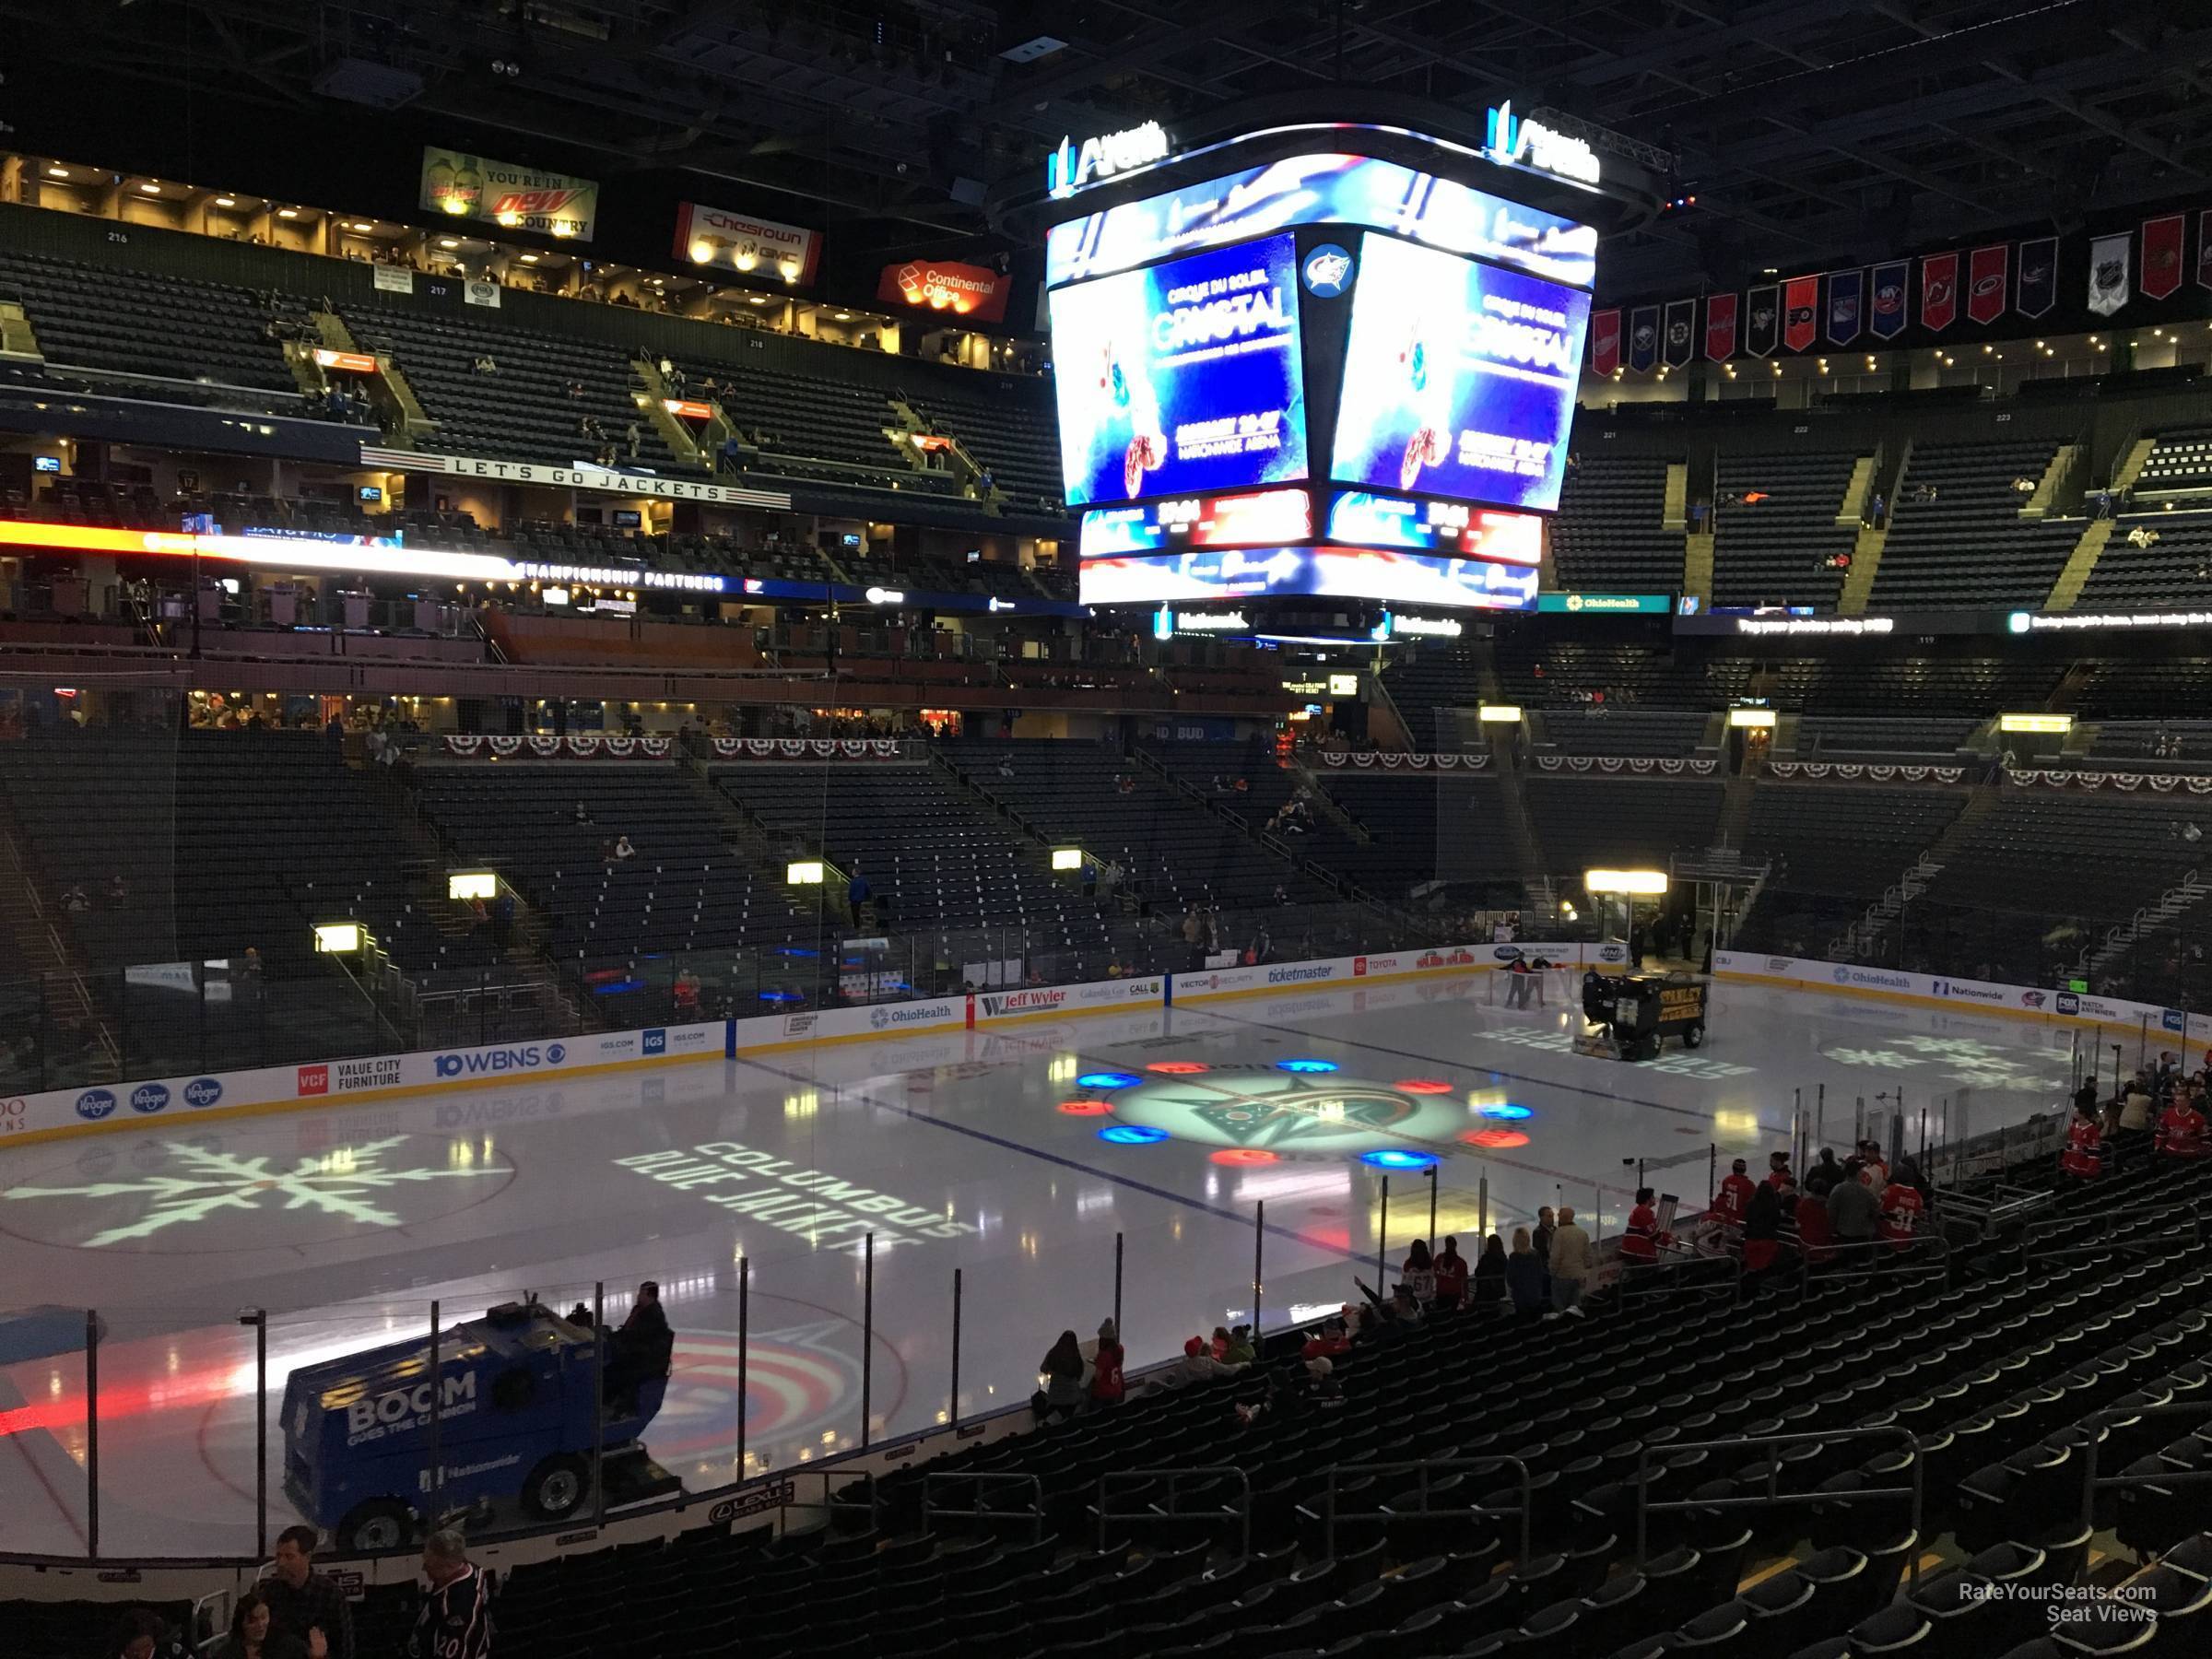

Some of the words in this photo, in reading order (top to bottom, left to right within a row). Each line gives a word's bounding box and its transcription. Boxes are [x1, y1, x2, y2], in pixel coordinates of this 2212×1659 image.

[487, 171, 541, 187] YOU'RE
[542, 177, 562, 189] IN
[515, 214, 587, 232] COUNTRY
[703, 213, 801, 245] Chesrown
[108, 232, 127, 243] 216
[759, 247, 798, 263] GMC
[430, 285, 447, 296] 217
[926, 270, 994, 295] Continental
[1210, 277, 1227, 295] DU
[1229, 268, 1269, 291] SOLEIL
[923, 284, 960, 302] Office
[750, 340, 763, 349] 218
[454, 459, 532, 479] LET'S
[552, 470, 583, 485] GO
[600, 476, 719, 500] JACKETS
[514, 562, 640, 586] CHAMPIONSHIP
[645, 571, 724, 592] PARTNERS
[1584, 598, 1640, 608] OhioHealth
[1919, 636, 1935, 644] 119
[1177, 726, 1205, 739] BUD
[1369, 959, 1397, 970] TOYOTA
[1715, 957, 1732, 965] CBJ
[1268, 965, 1333, 983] ticketmaster
[1852, 972, 1911, 989] OhioHealth
[1129, 983, 1149, 994] CALL
[1180, 979, 1208, 988] VECTOR
[1006, 993, 1029, 1008] Jeff
[1029, 989, 1066, 1006] Wyler
[1951, 985, 2003, 1001] Nationwide
[2058, 996, 2078, 1008] FOX
[891, 1005, 951, 1023] OhioHealth
[2080, 1001, 2104, 1009] WATCH
[2080, 1008, 2116, 1018] ANYWHERE
[600, 1039, 634, 1050] IGS.COM
[645, 1035, 664, 1047] IGS
[674, 1031, 705, 1042] IGS.COM
[338, 1062, 372, 1077] VALUE
[376, 1059, 401, 1074] CITY
[434, 1054, 463, 1077] 10
[465, 1047, 541, 1072] WBNS
[300, 1073, 327, 1088] VCF
[338, 1073, 401, 1090] FURNITURE
[134, 1089, 168, 1110] Kroger
[187, 1083, 220, 1104] Kroger
[80, 1096, 112, 1116] Kroger
[693, 1142, 979, 1238] COLUMBUS
[610, 1149, 747, 1190] BLUE
[703, 1187, 925, 1257] JACKETS
[1725, 1191, 1738, 1210] 31
[1890, 1206, 1915, 1232] 31
[347, 1371, 477, 1434] BOOM
[347, 1427, 384, 1446] GOES
[387, 1418, 415, 1435] THE
[733, 1484, 793, 1510] LEXUS
